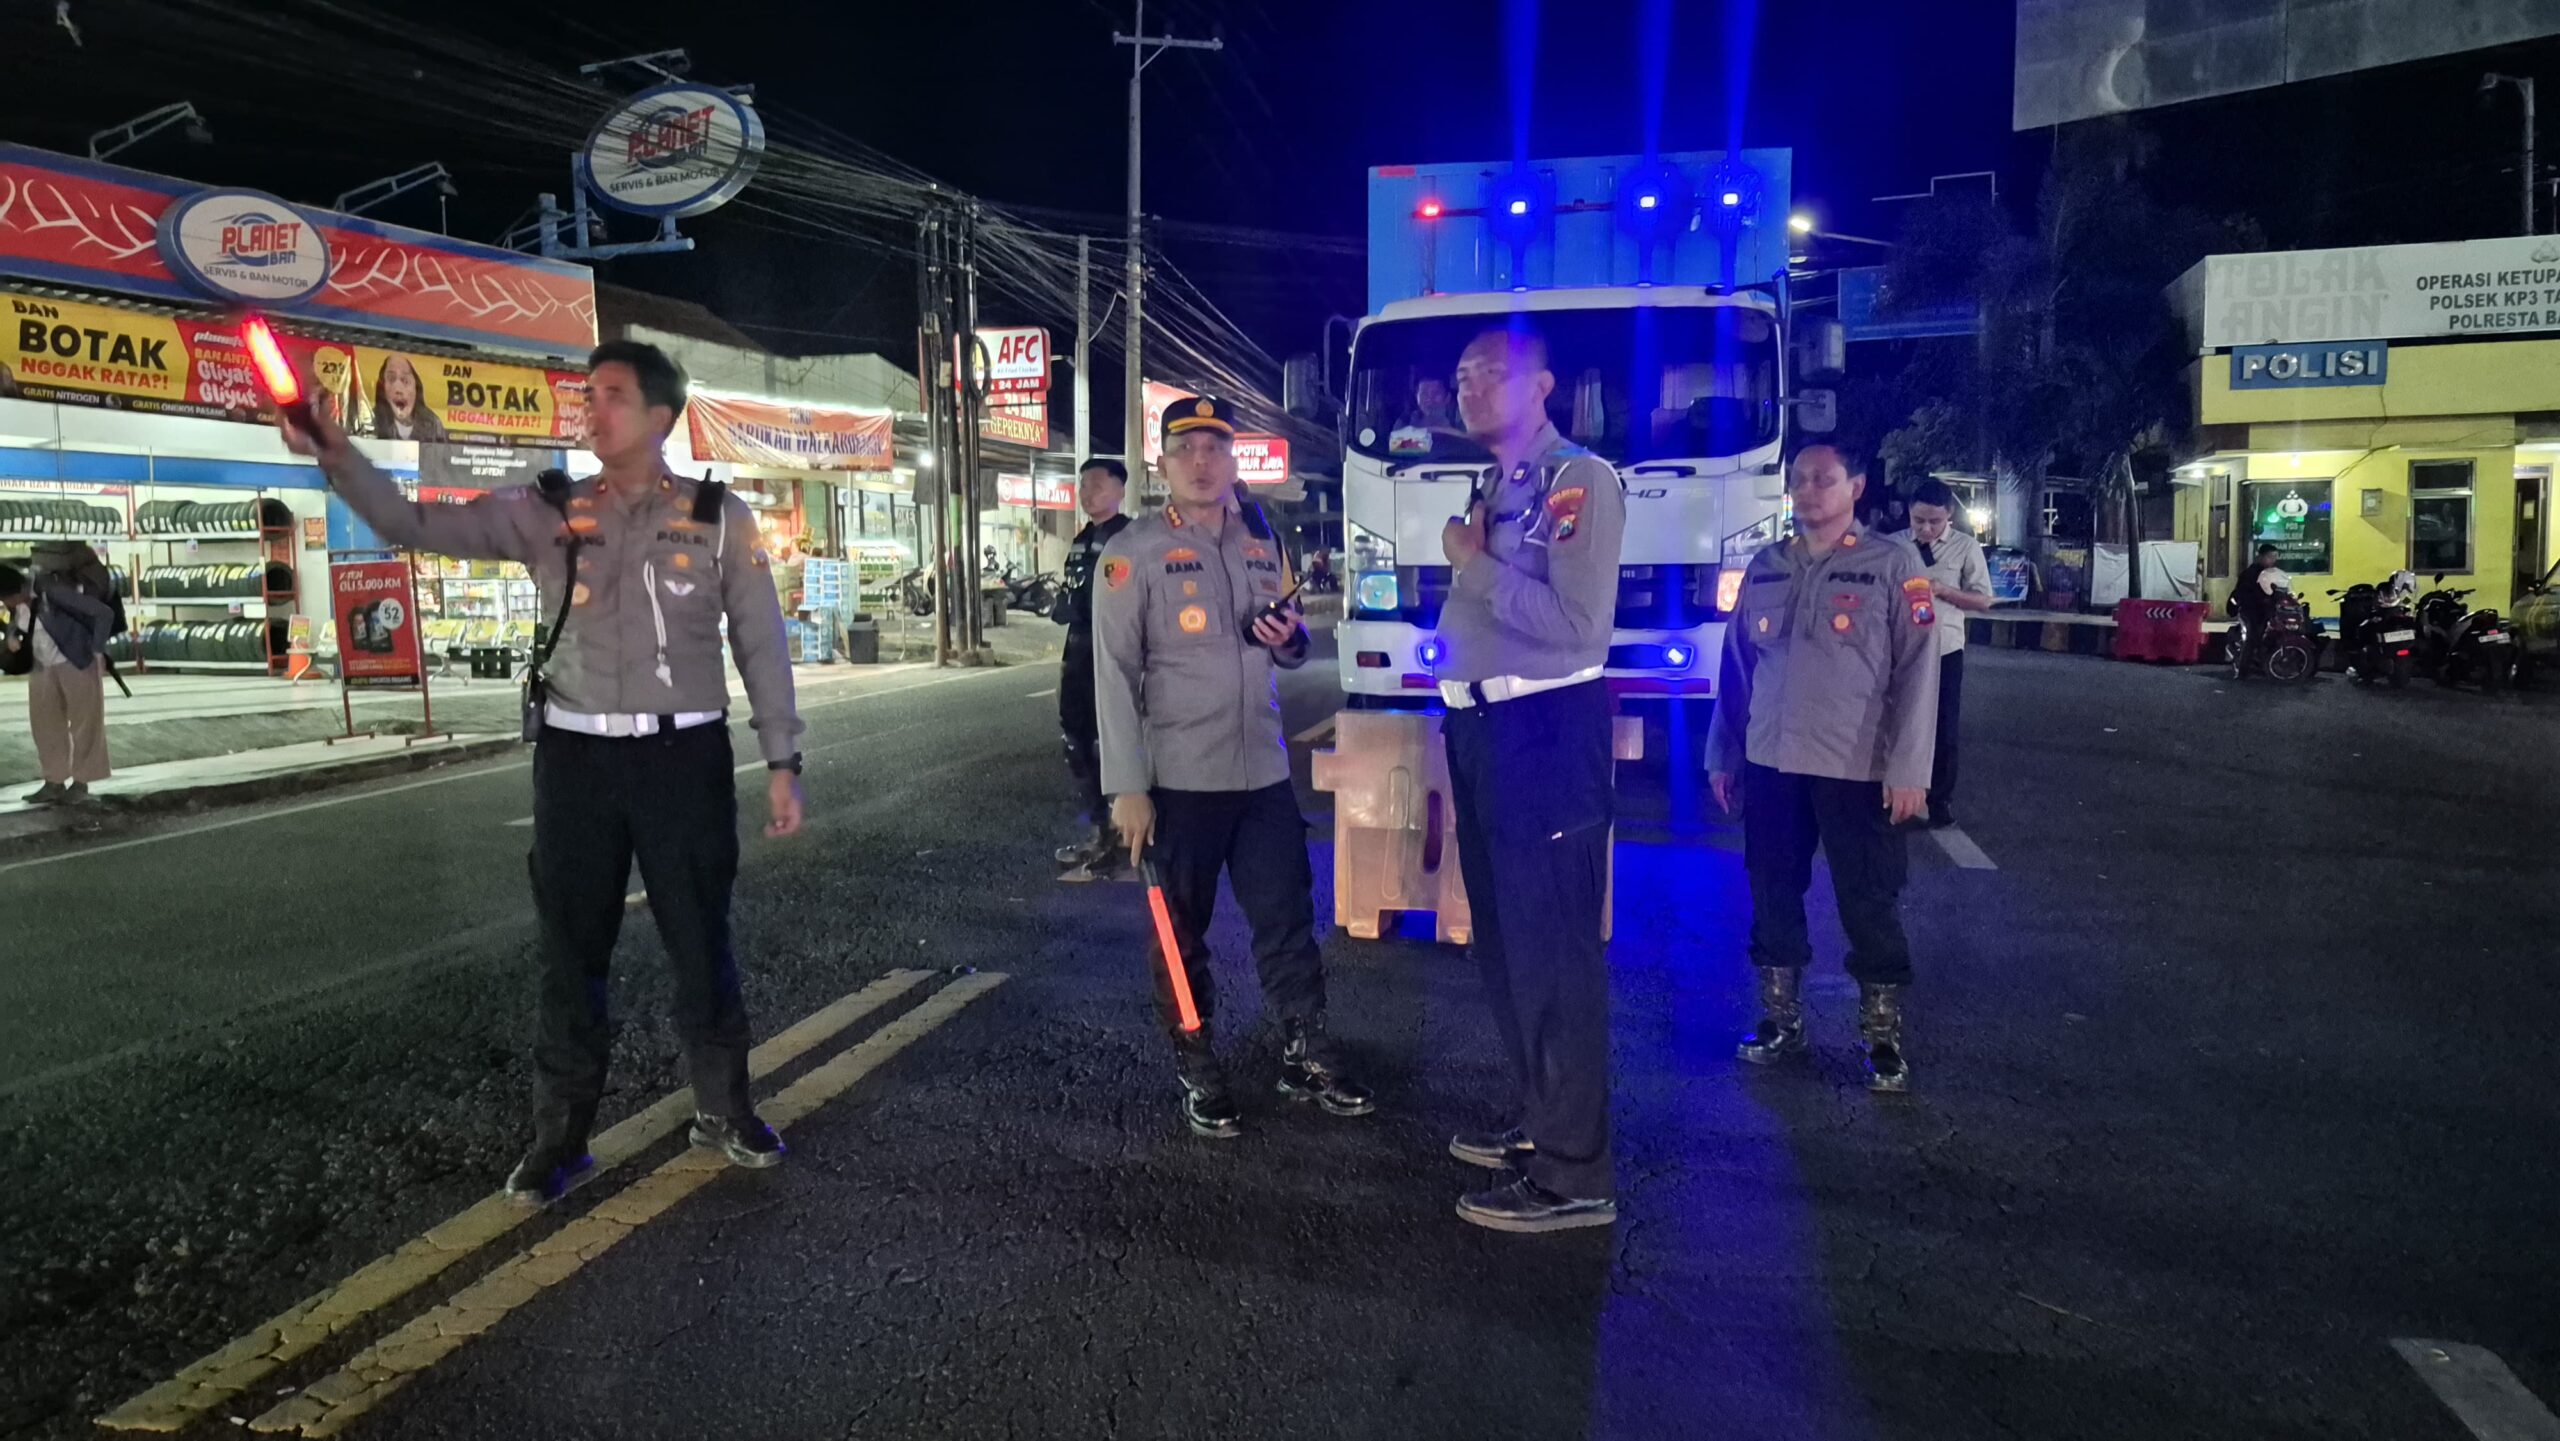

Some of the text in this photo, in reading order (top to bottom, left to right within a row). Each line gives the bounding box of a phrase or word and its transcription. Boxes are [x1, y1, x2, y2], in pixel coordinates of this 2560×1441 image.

[609, 168, 720, 193] SERVIS & BAN MOTOR
[222, 223, 301, 254] PLANET
[270, 252, 297, 265] BAN
[203, 265, 309, 288] SERVIS & BAN MOTOR
[2207, 251, 2386, 298] TOLAK
[2416, 272, 2491, 291] OPERASI
[12, 300, 59, 319] BAN
[2429, 292, 2498, 311] POLSEK
[2504, 290, 2538, 307] KP3
[2220, 295, 2381, 344] ANGIN
[2449, 311, 2540, 330] POLRESTA
[18, 318, 169, 371] BOTAK
[998, 335, 1039, 364] AFC
[194, 348, 221, 361] BAN
[21, 356, 169, 390] NGGAK RATA?!
[197, 360, 254, 388] Gliyat
[443, 364, 472, 379] BAN
[2242, 350, 2379, 380] POLISI
[998, 379, 1012, 390] 24
[1016, 378, 1040, 389] JAM
[23, 387, 100, 404] GRATIS NITROGEN
[200, 381, 258, 410] Gliyut
[447, 380, 541, 413] BOTAK
[132, 399, 161, 411] GRATIS
[195, 407, 227, 418] PASANG
[447, 410, 542, 429] NGGAK RATA?!
[1262, 456, 1284, 470] JAYA
[656, 530, 709, 547] POLRI
[1165, 561, 1204, 574] RAMA
[1246, 560, 1277, 573] POLRI
[340, 581, 356, 593] OLI
[384, 577, 402, 589] KM
[1828, 572, 1876, 586] POLRI
[384, 605, 400, 621] 52
